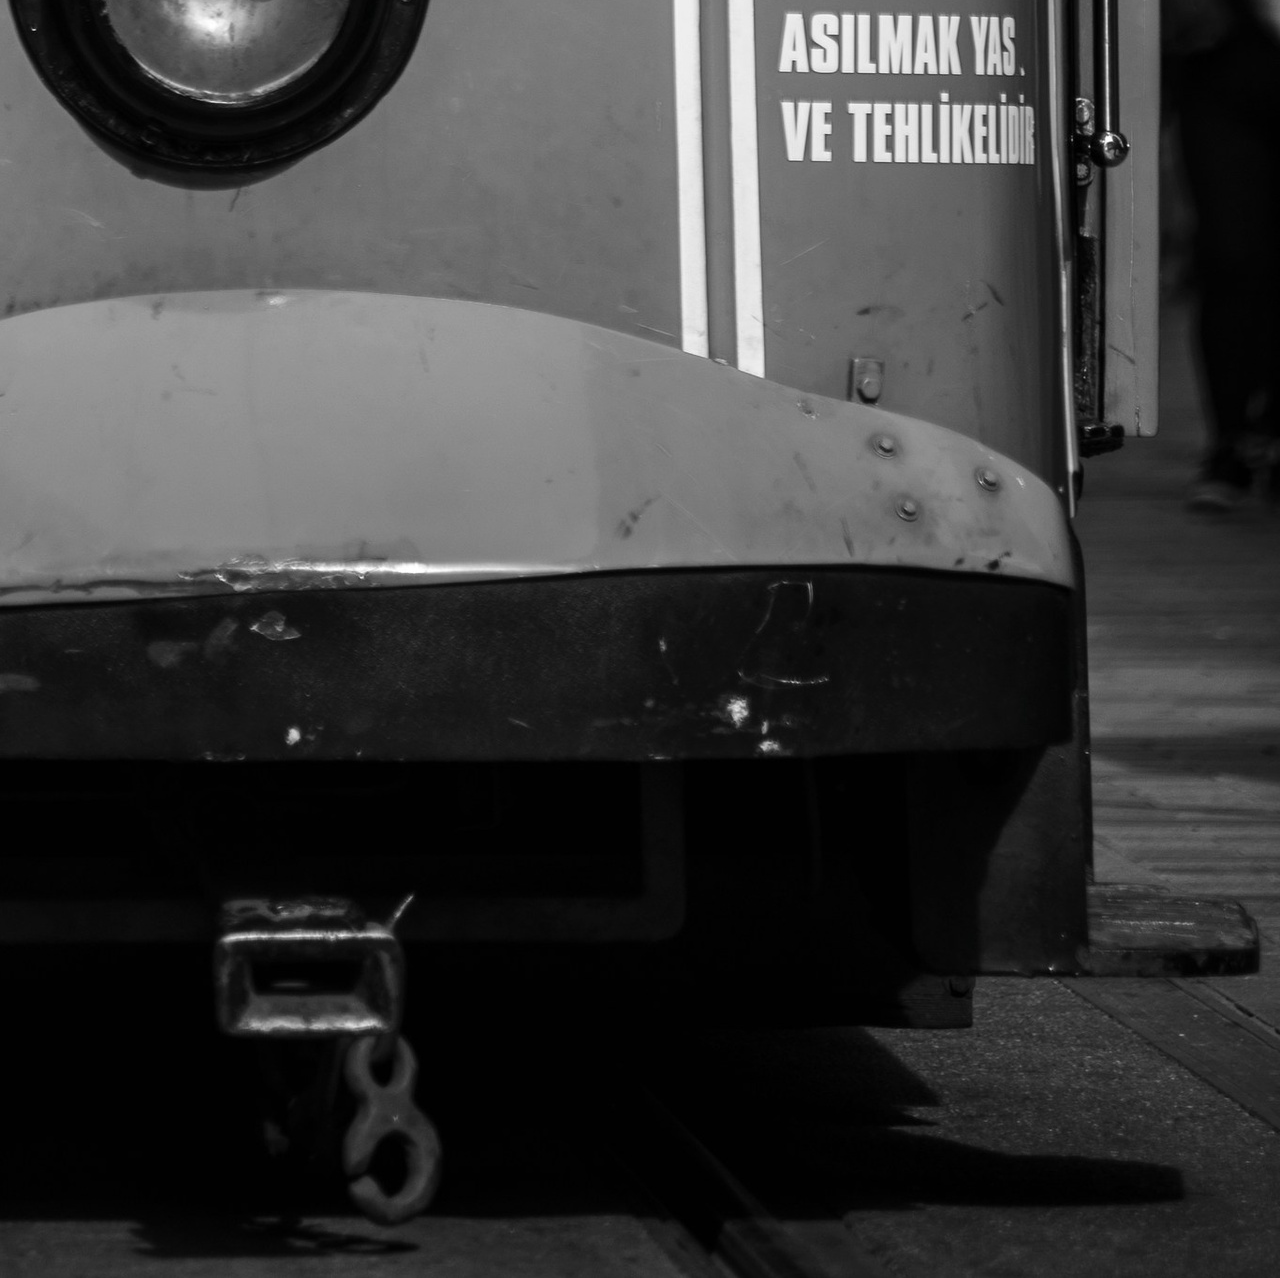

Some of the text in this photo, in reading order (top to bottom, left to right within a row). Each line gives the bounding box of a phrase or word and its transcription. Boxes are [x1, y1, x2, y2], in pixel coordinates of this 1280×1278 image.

[778, 13, 961, 75] ASILMAK
[780, 93, 1035, 165] VE TEHLİKELİDİR
